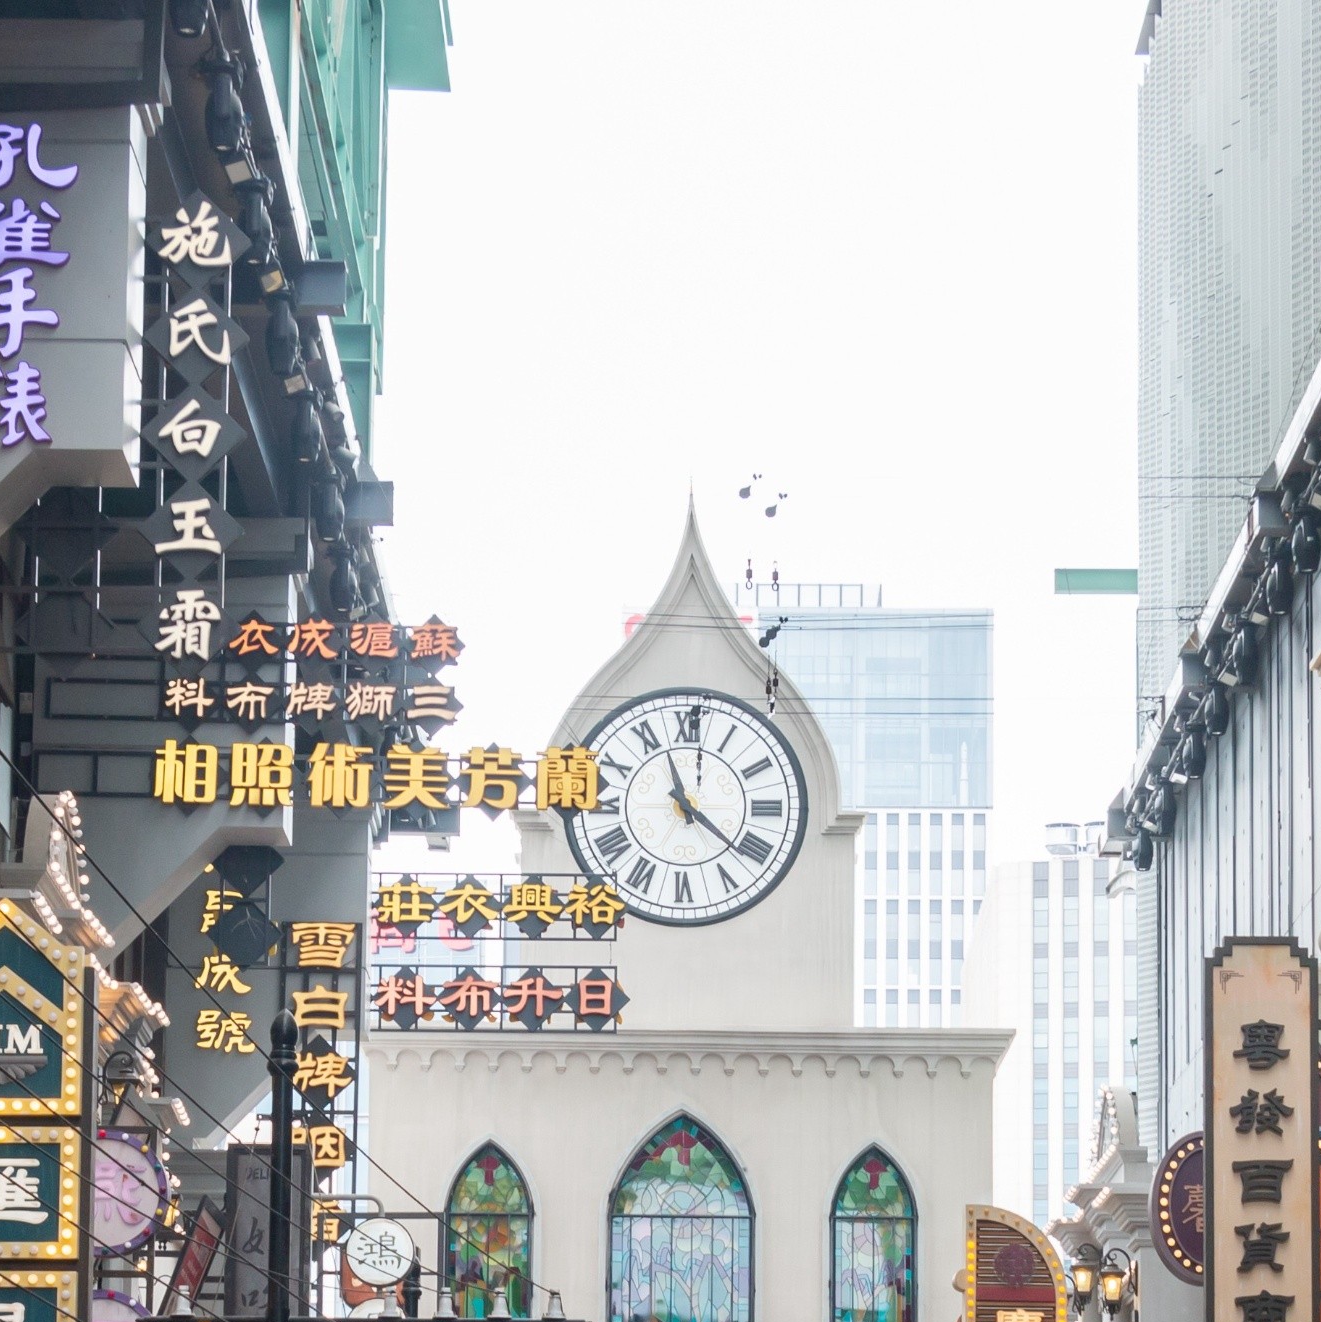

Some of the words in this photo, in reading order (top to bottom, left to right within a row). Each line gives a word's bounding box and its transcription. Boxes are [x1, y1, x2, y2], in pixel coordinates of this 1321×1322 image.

[155, 200, 233, 661] 施氏白玉霜
[153, 738, 601, 812] 蘭芳美術照相
[378, 882, 625, 925] 裕興衣莊
[374, 975, 613, 1017] 日升布料
